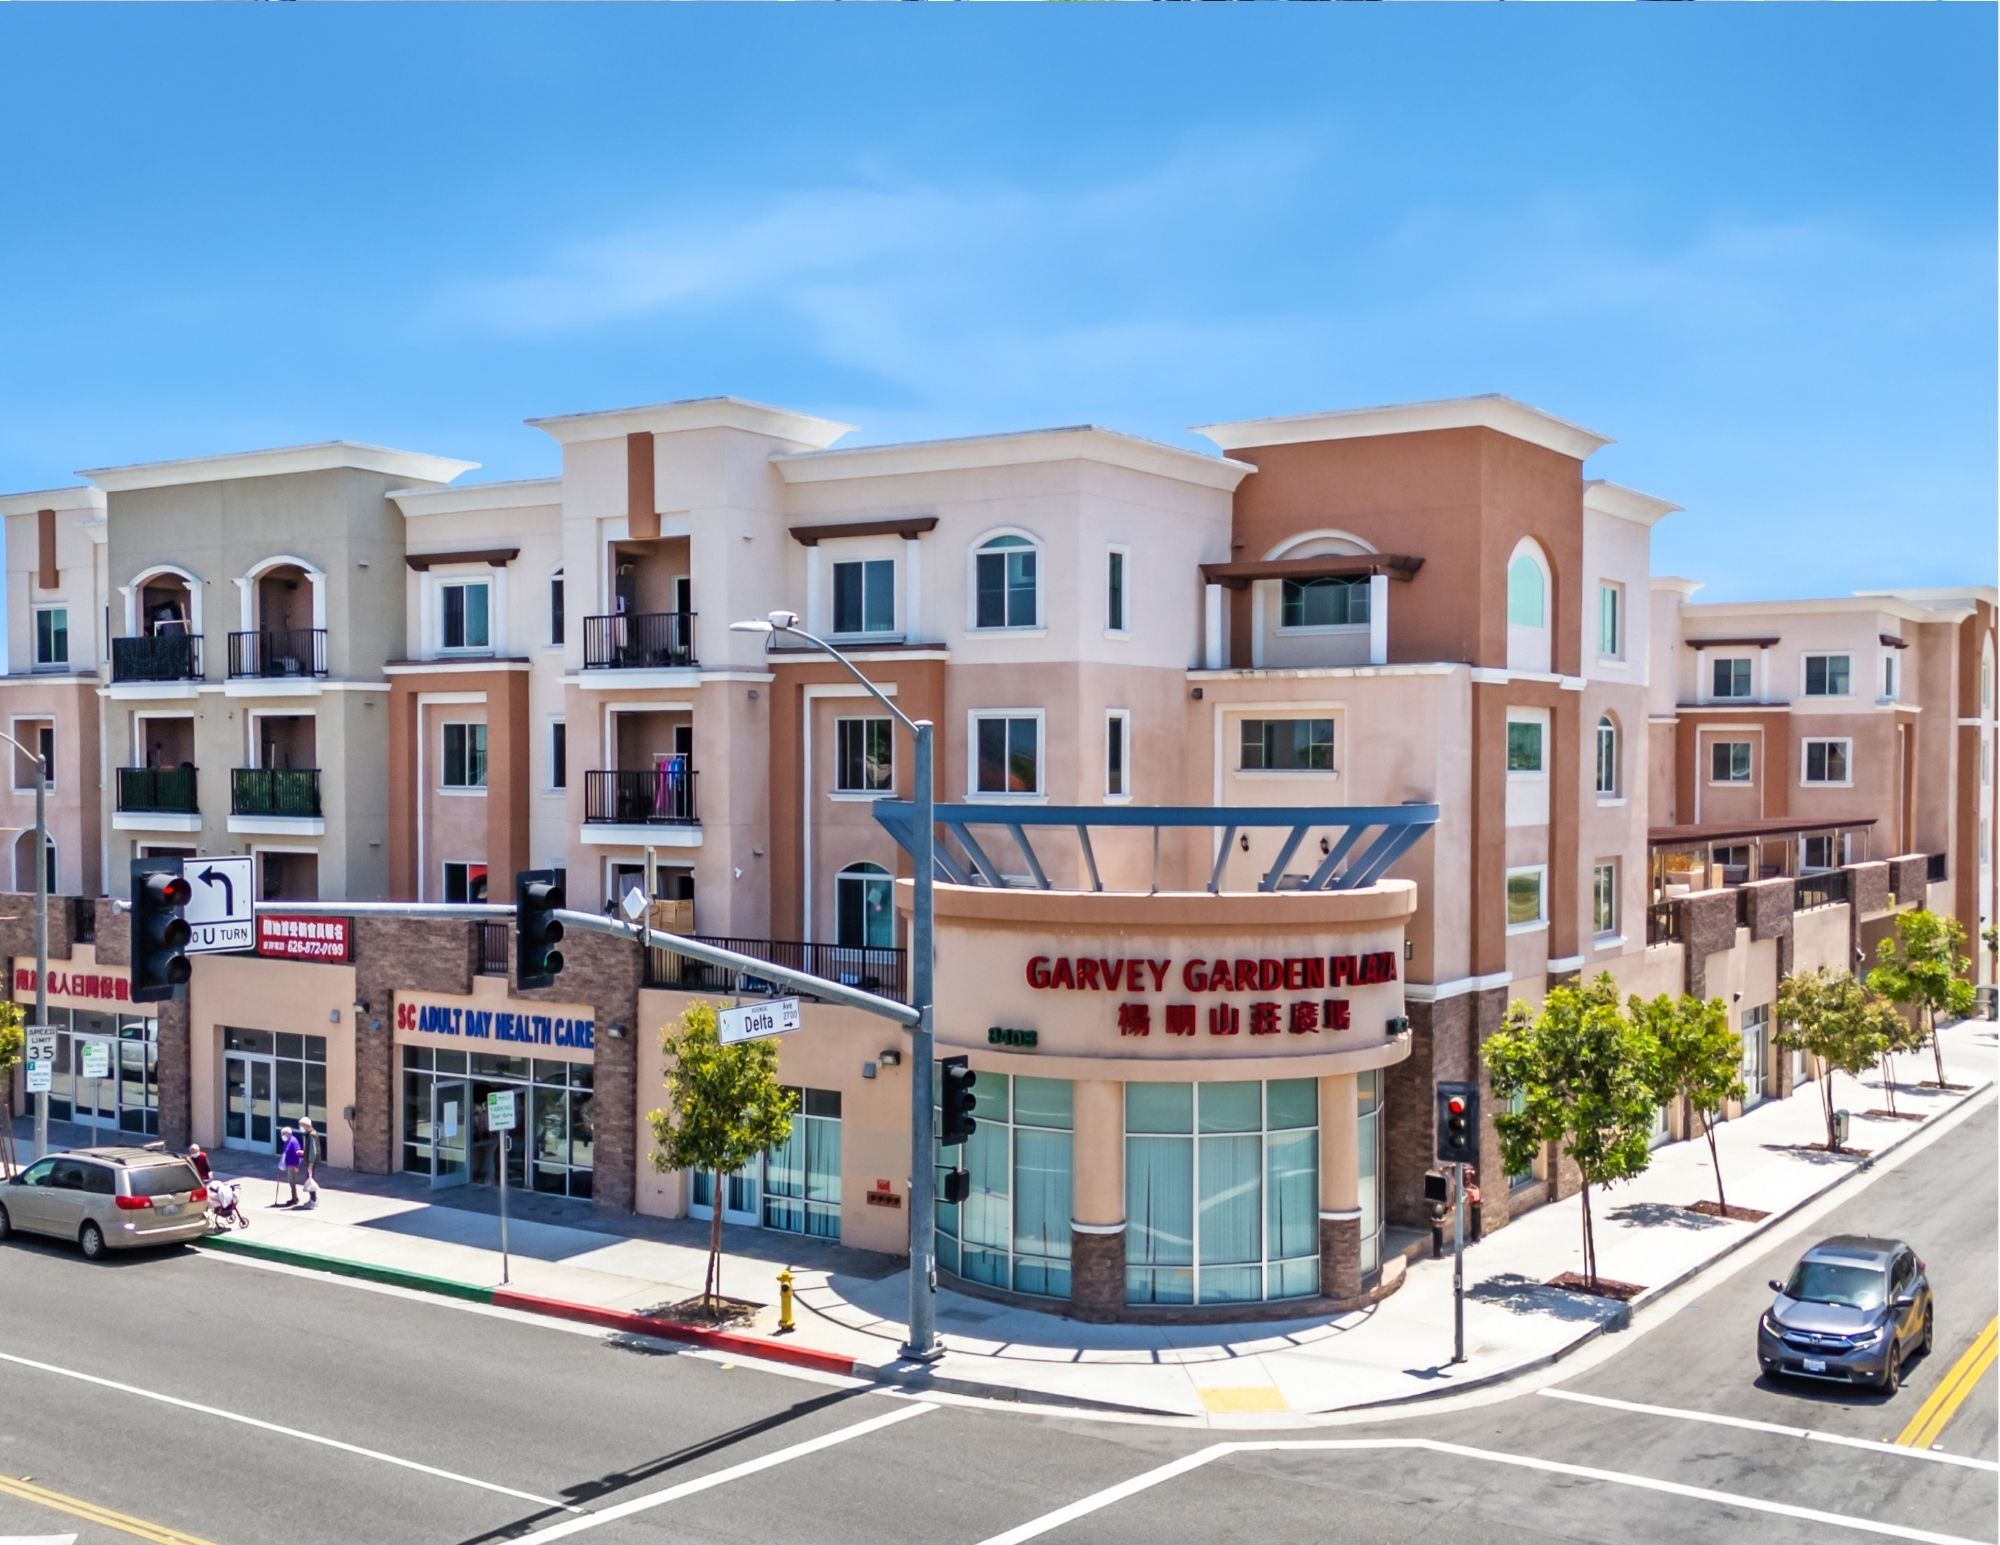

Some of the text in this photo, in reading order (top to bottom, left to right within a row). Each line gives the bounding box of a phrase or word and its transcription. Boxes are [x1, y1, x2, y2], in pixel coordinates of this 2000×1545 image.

[203, 928, 215, 945] U
[220, 928, 248, 941] TURN
[1026, 951, 1397, 992] GARVEY GARDEN PLAZA
[782, 1002, 793, 1010] Ave
[783, 1010, 798, 1021] 2700
[28, 1027, 55, 1035] SPEED
[397, 1002, 595, 1049] SC ADULT DAY HEALTH CARE
[744, 1014, 774, 1033] Delta
[29, 1046, 54, 1060] 35
